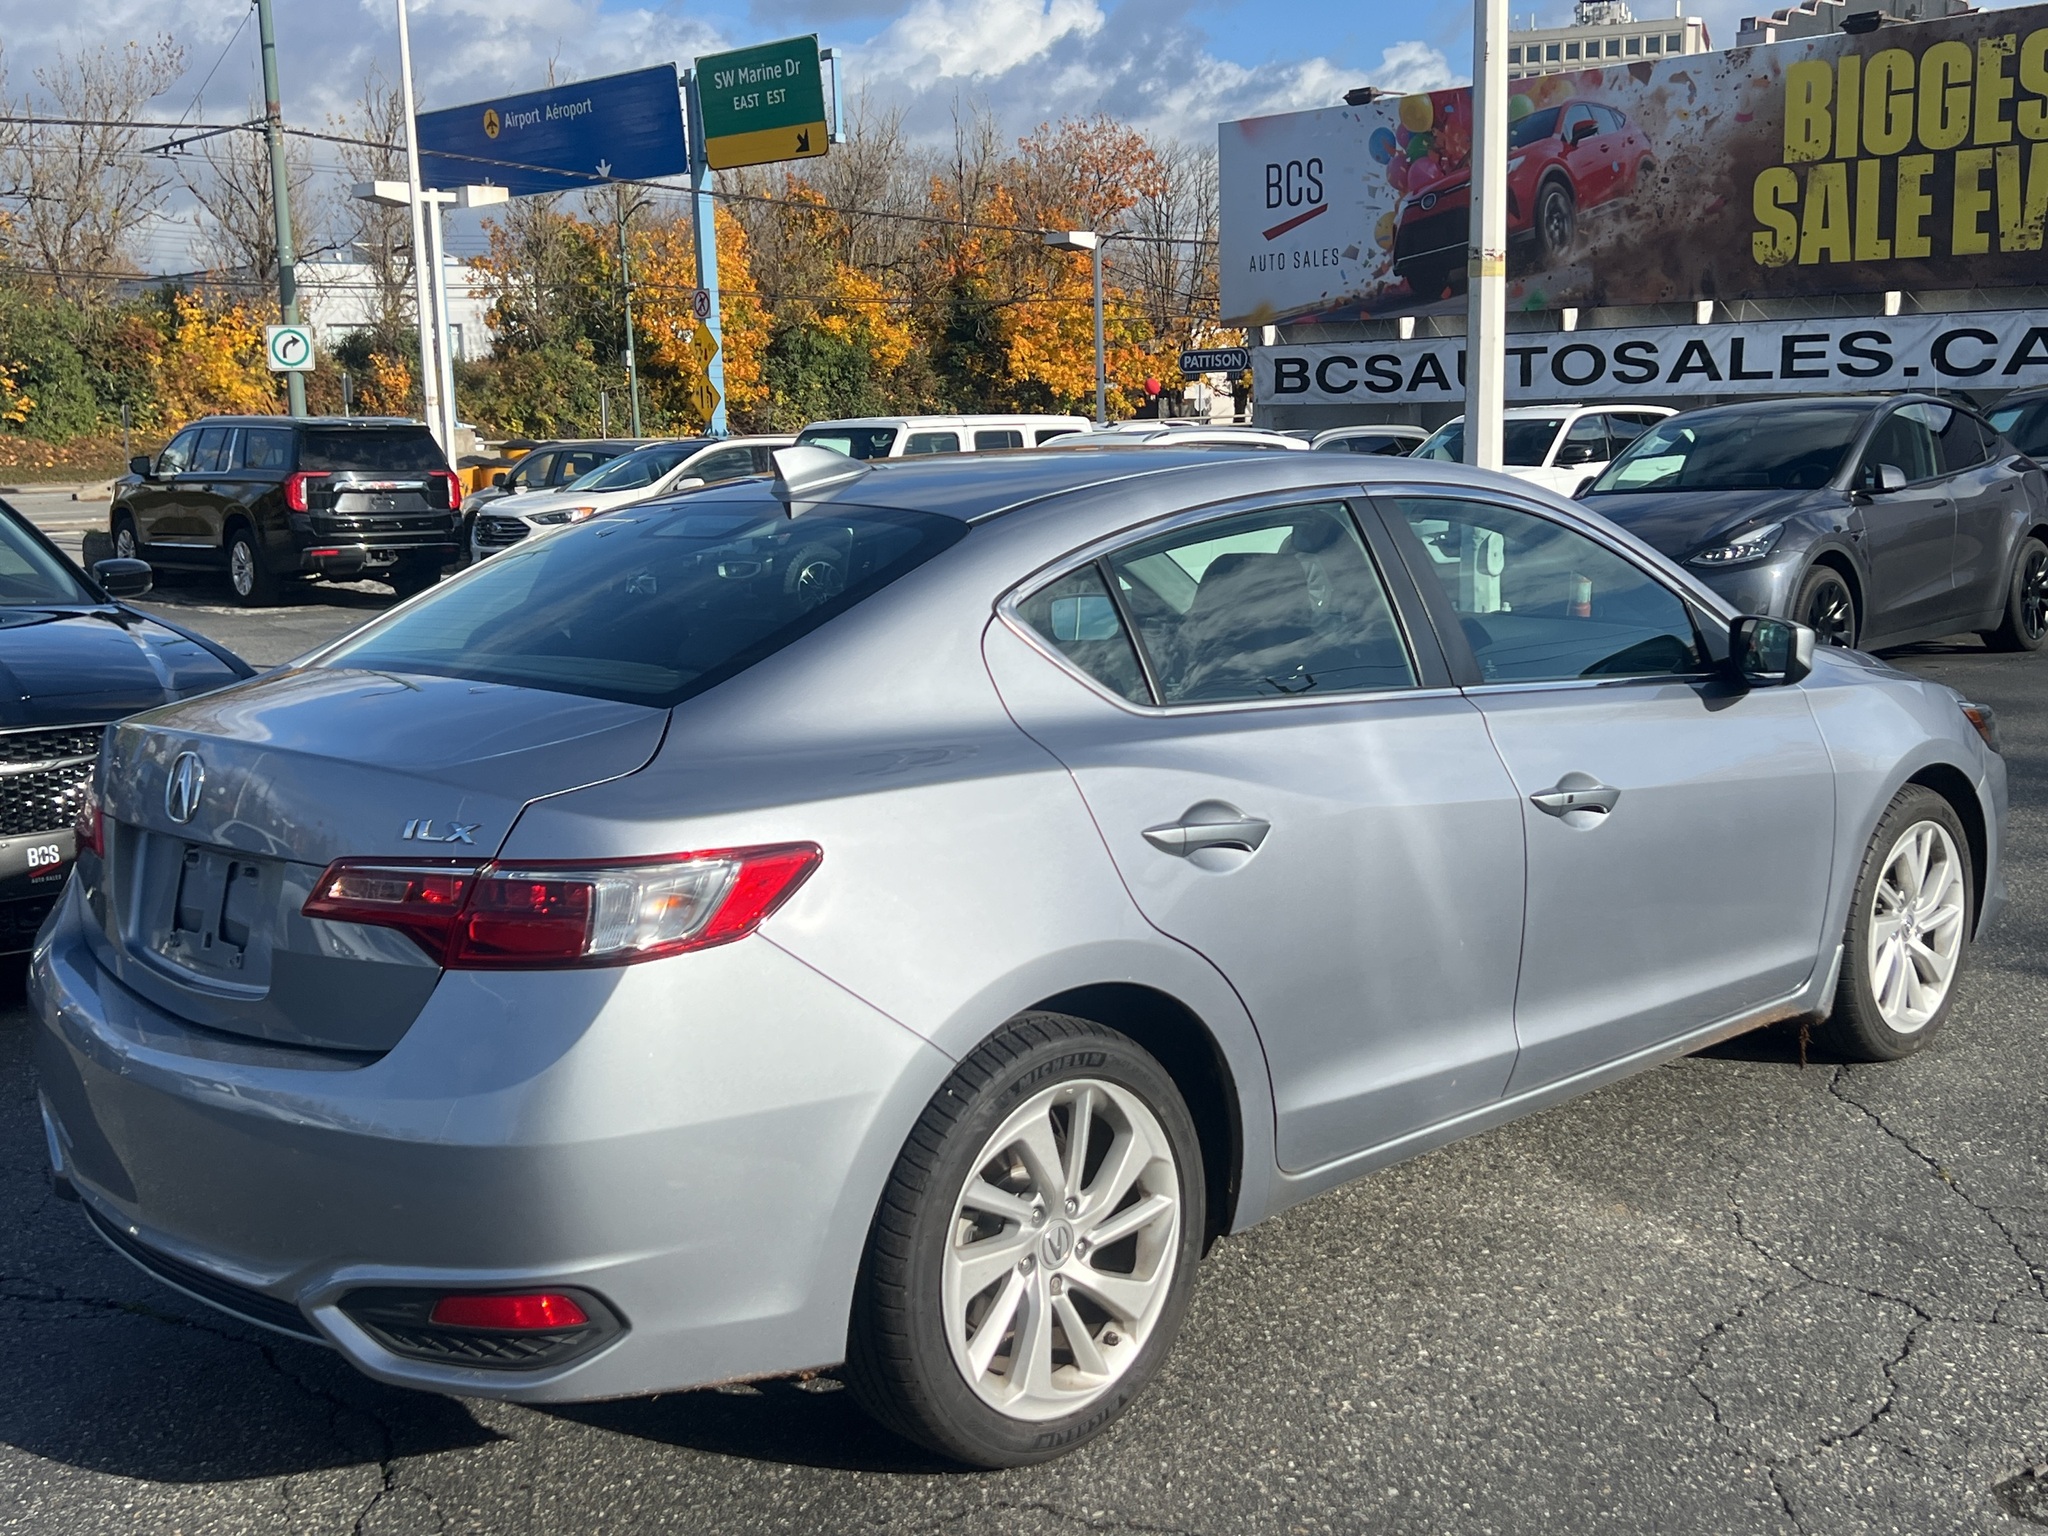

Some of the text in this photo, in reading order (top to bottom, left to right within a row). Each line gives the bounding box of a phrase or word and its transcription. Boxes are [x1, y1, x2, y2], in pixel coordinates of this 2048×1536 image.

[714, 59, 801, 89] SW Marine Dr
[505, 98, 593, 130] Airport Aéroport
[733, 89, 786, 110] EAST EST
[1266, 157, 1323, 209] BCS
[1752, 153, 1934, 268] SALE
[1249, 247, 1339, 273] AUTO SALES
[1183, 351, 1243, 369] PATTISON
[1274, 327, 2048, 394] BCSATOSALES.CA
[402, 818, 482, 846] ILX
[27, 844, 60, 867] BCS
[1019, 1053, 1102, 1090] MICHELIN
